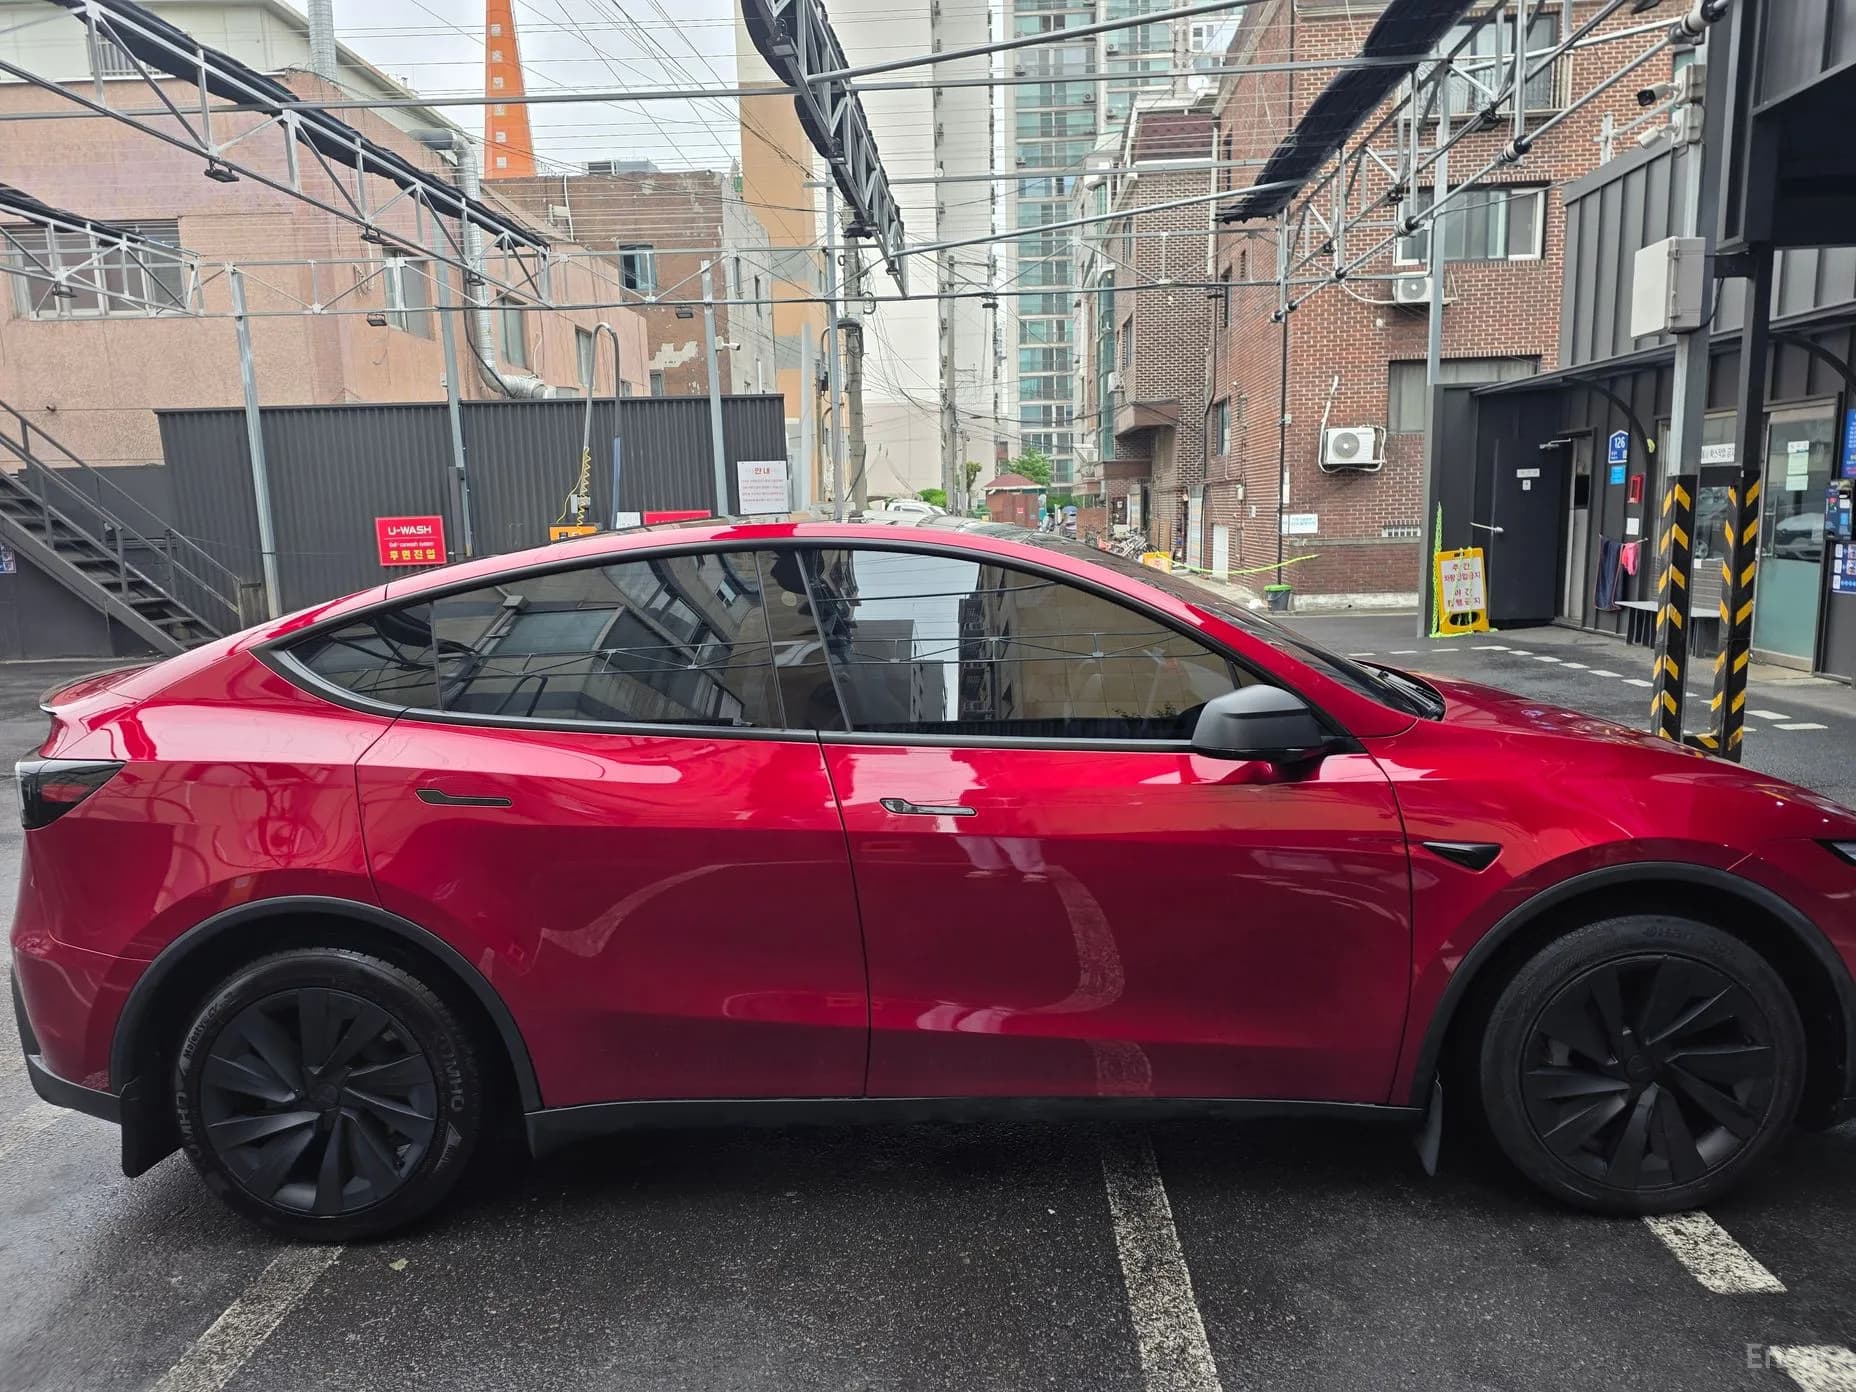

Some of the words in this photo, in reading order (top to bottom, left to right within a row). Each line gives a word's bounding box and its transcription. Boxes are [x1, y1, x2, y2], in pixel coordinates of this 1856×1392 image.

[1614, 436, 1626, 449] 126
[754, 467, 770, 475] 안내
[388, 525, 432, 535] U-WASH
